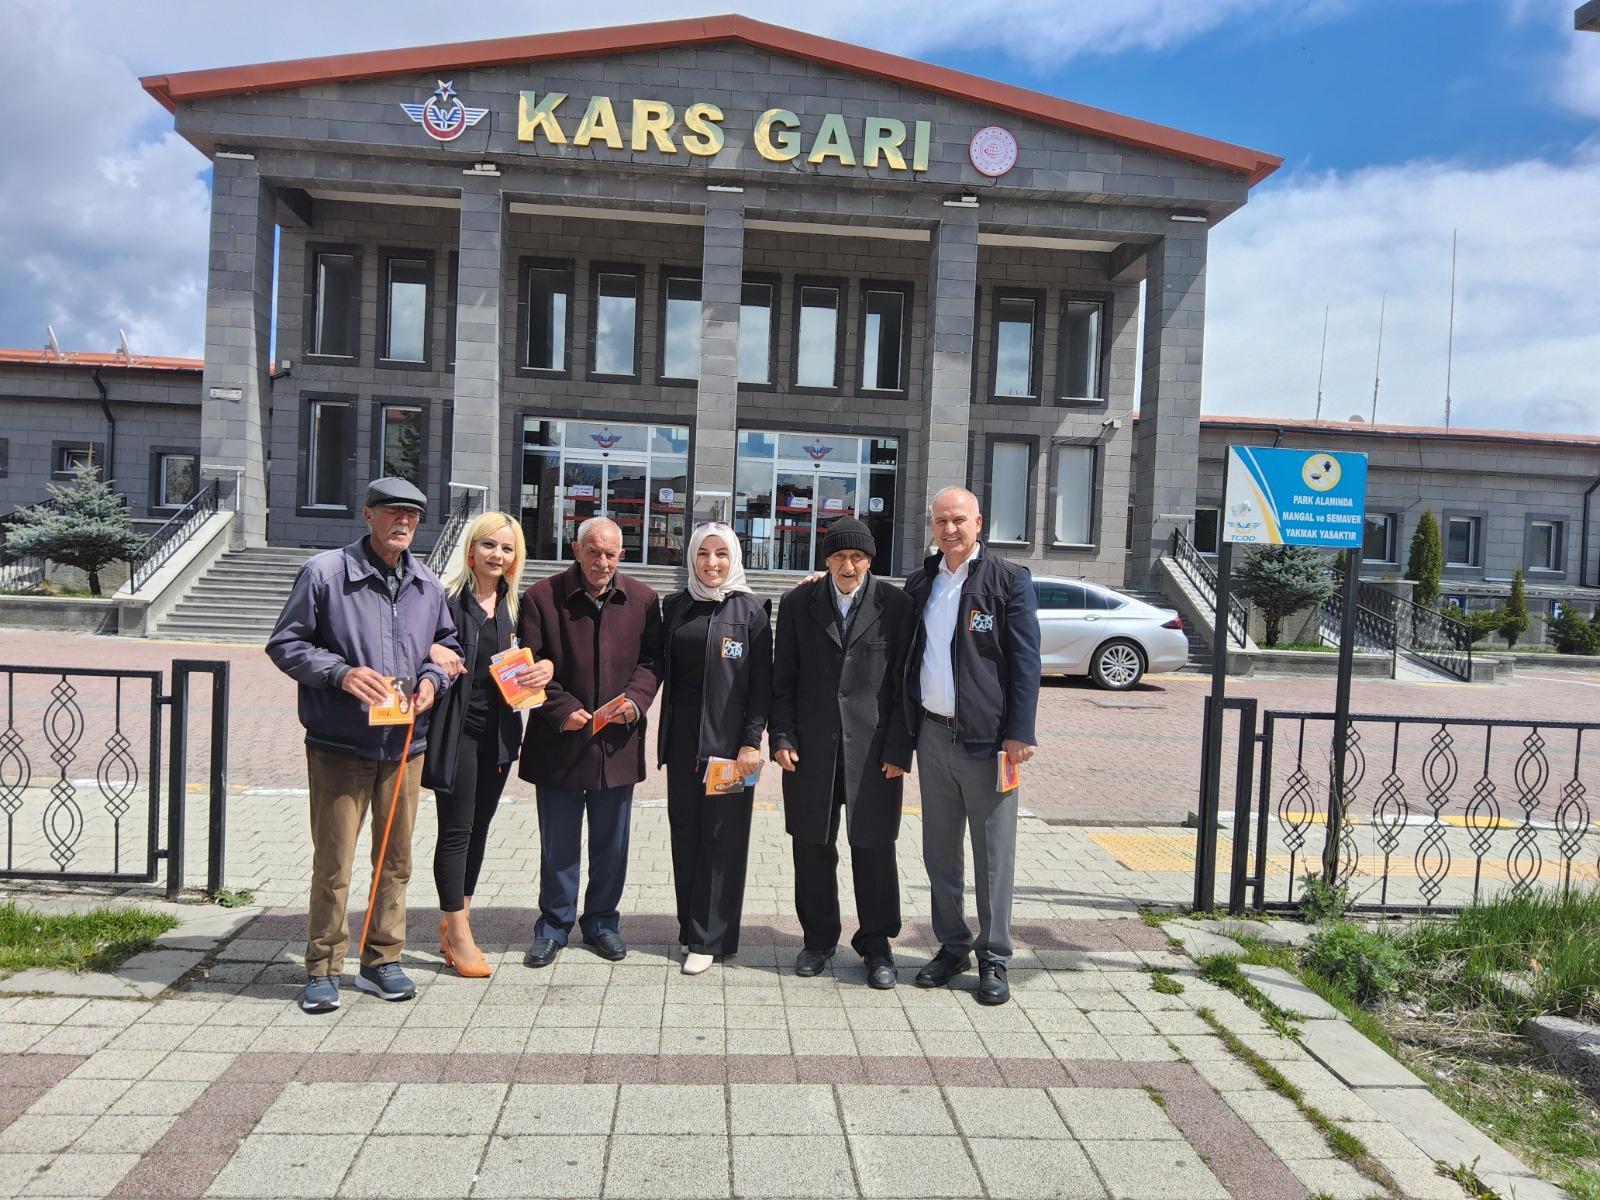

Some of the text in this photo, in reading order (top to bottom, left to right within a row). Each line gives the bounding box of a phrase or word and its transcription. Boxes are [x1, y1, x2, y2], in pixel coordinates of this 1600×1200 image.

[517, 90, 725, 156] KARS
[753, 108, 931, 171] GARI
[1293, 495, 1353, 507] PARK ALANINDA
[1282, 511, 1314, 522] MANGAL
[1326, 513, 1361, 524] SEMAVER
[1231, 534, 1256, 542] TCDD
[1286, 528, 1357, 540] YAKMAK YASAKTIR
[971, 620, 993, 631] KAPI
[724, 647, 743, 657] KAPI
